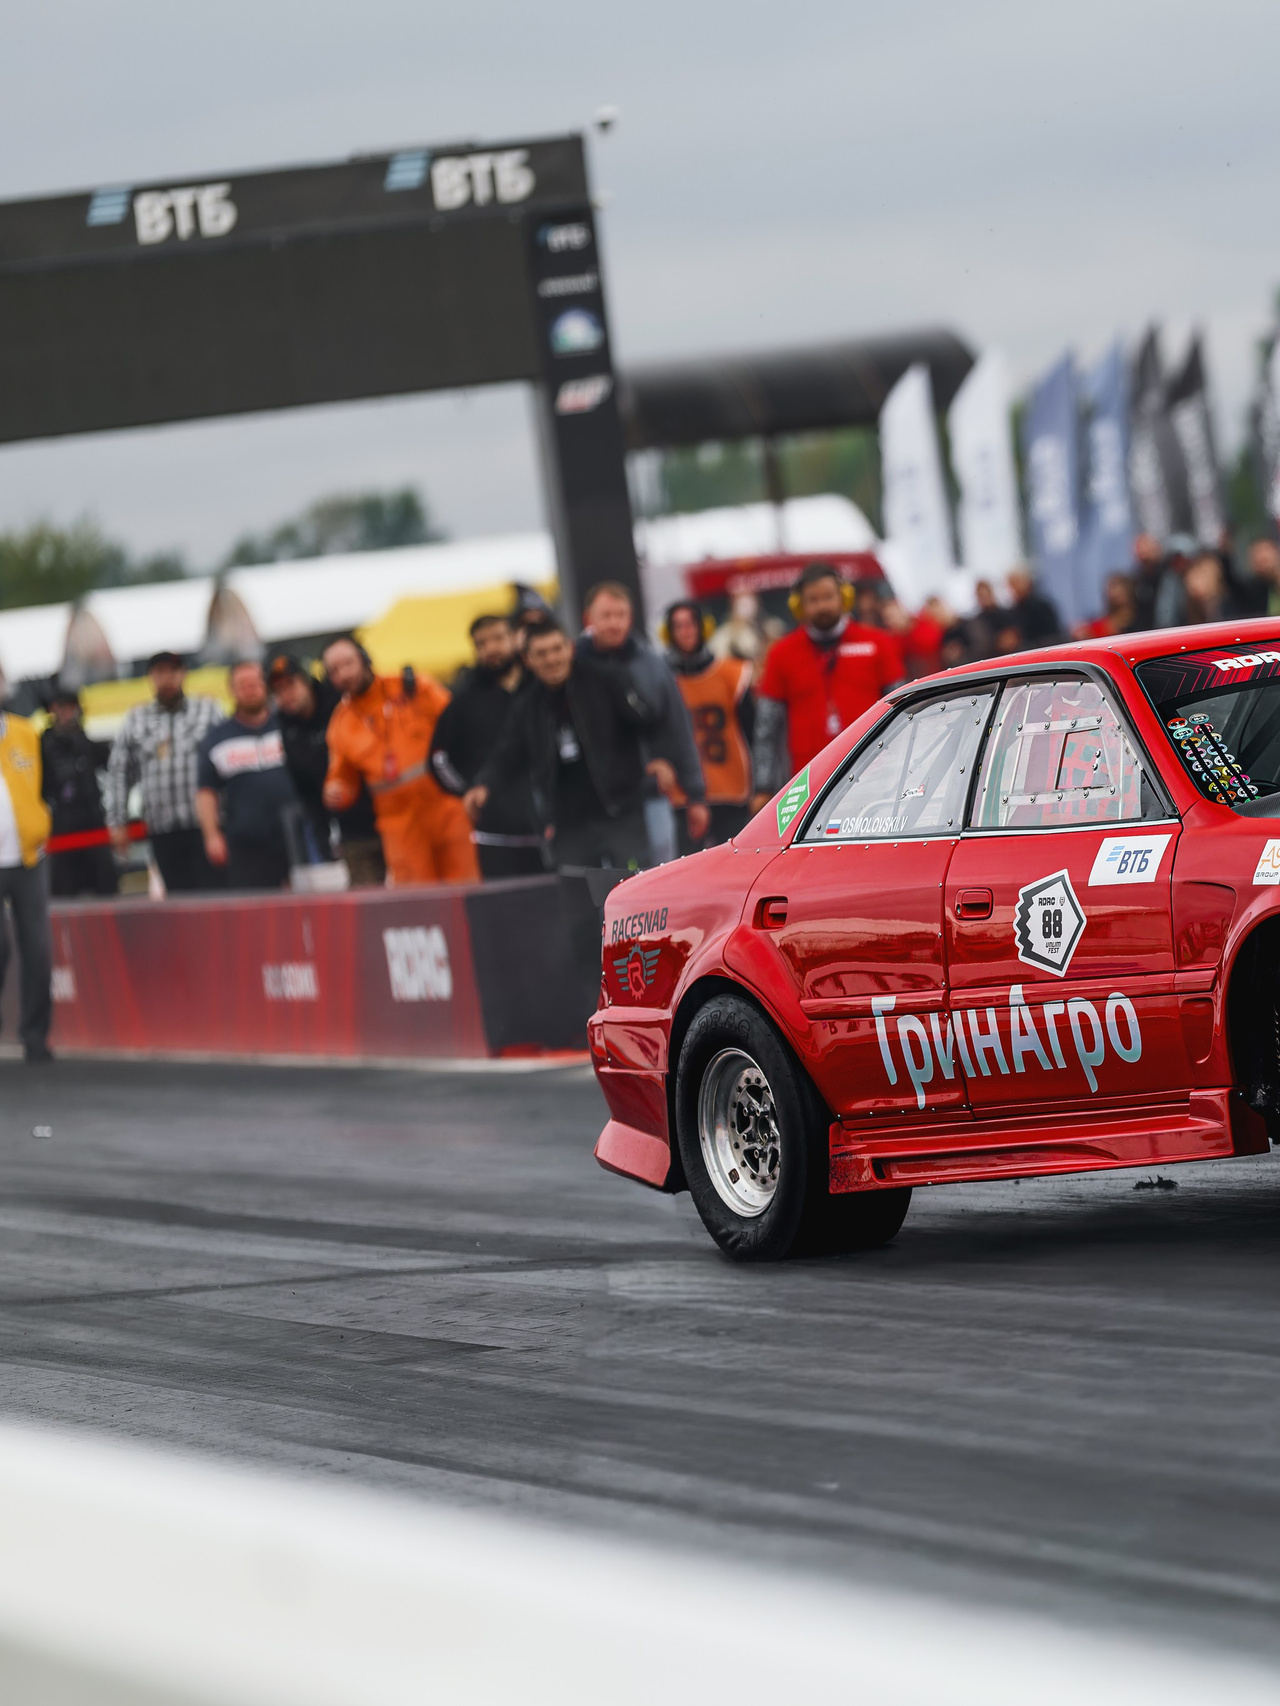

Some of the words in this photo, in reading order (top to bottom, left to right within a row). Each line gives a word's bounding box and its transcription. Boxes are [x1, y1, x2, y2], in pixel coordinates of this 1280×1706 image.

[430, 149, 537, 211] ВТБ
[133, 182, 238, 246] ВТБ
[1116, 849, 1153, 874] ВТБ
[611, 907, 669, 944] RACESNAB
[1041, 908, 1063, 939] 88
[871, 984, 1143, 1110] ГринАгро
